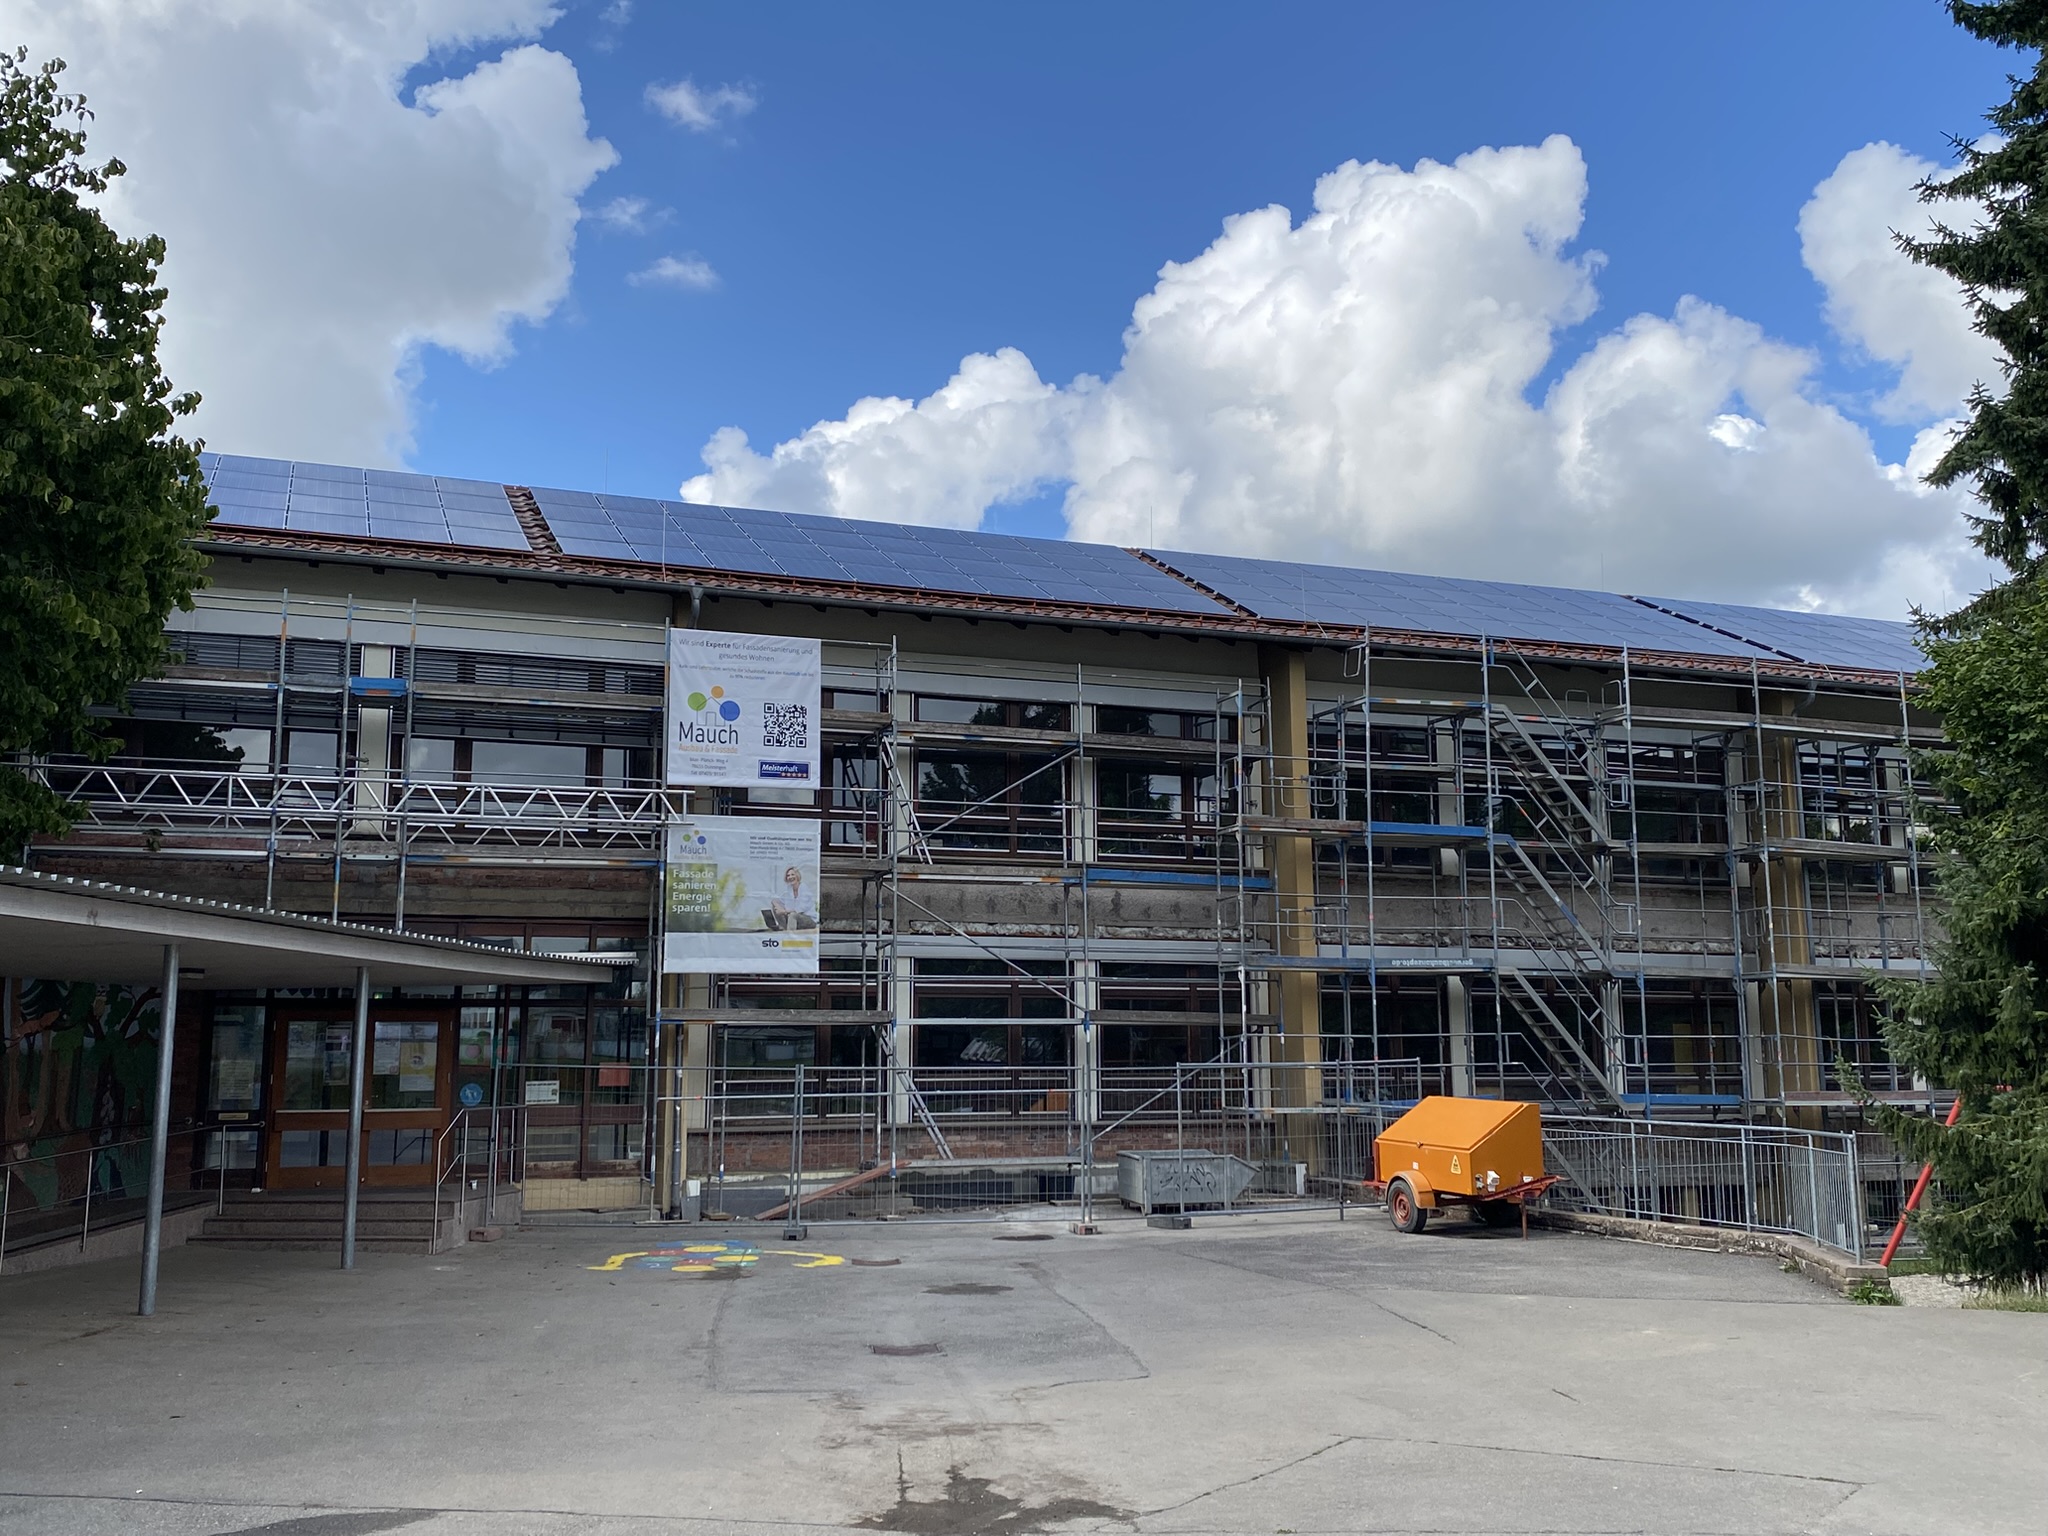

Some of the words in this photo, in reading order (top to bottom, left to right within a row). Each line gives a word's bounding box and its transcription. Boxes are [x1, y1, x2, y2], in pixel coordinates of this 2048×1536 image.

[705, 641, 731, 649] Experte
[742, 643, 800, 655] Fassadensanierung
[718, 652, 748, 661] gesundes
[749, 654, 775, 662] Wohnen
[679, 720, 739, 745] Mauch
[761, 763, 799, 773] Meisterhaft
[680, 844, 707, 855] Mauch
[673, 869, 714, 879] Fassade
[672, 891, 712, 904] Energie
[671, 903, 711, 914] sparen!
[761, 937, 780, 948] sto
